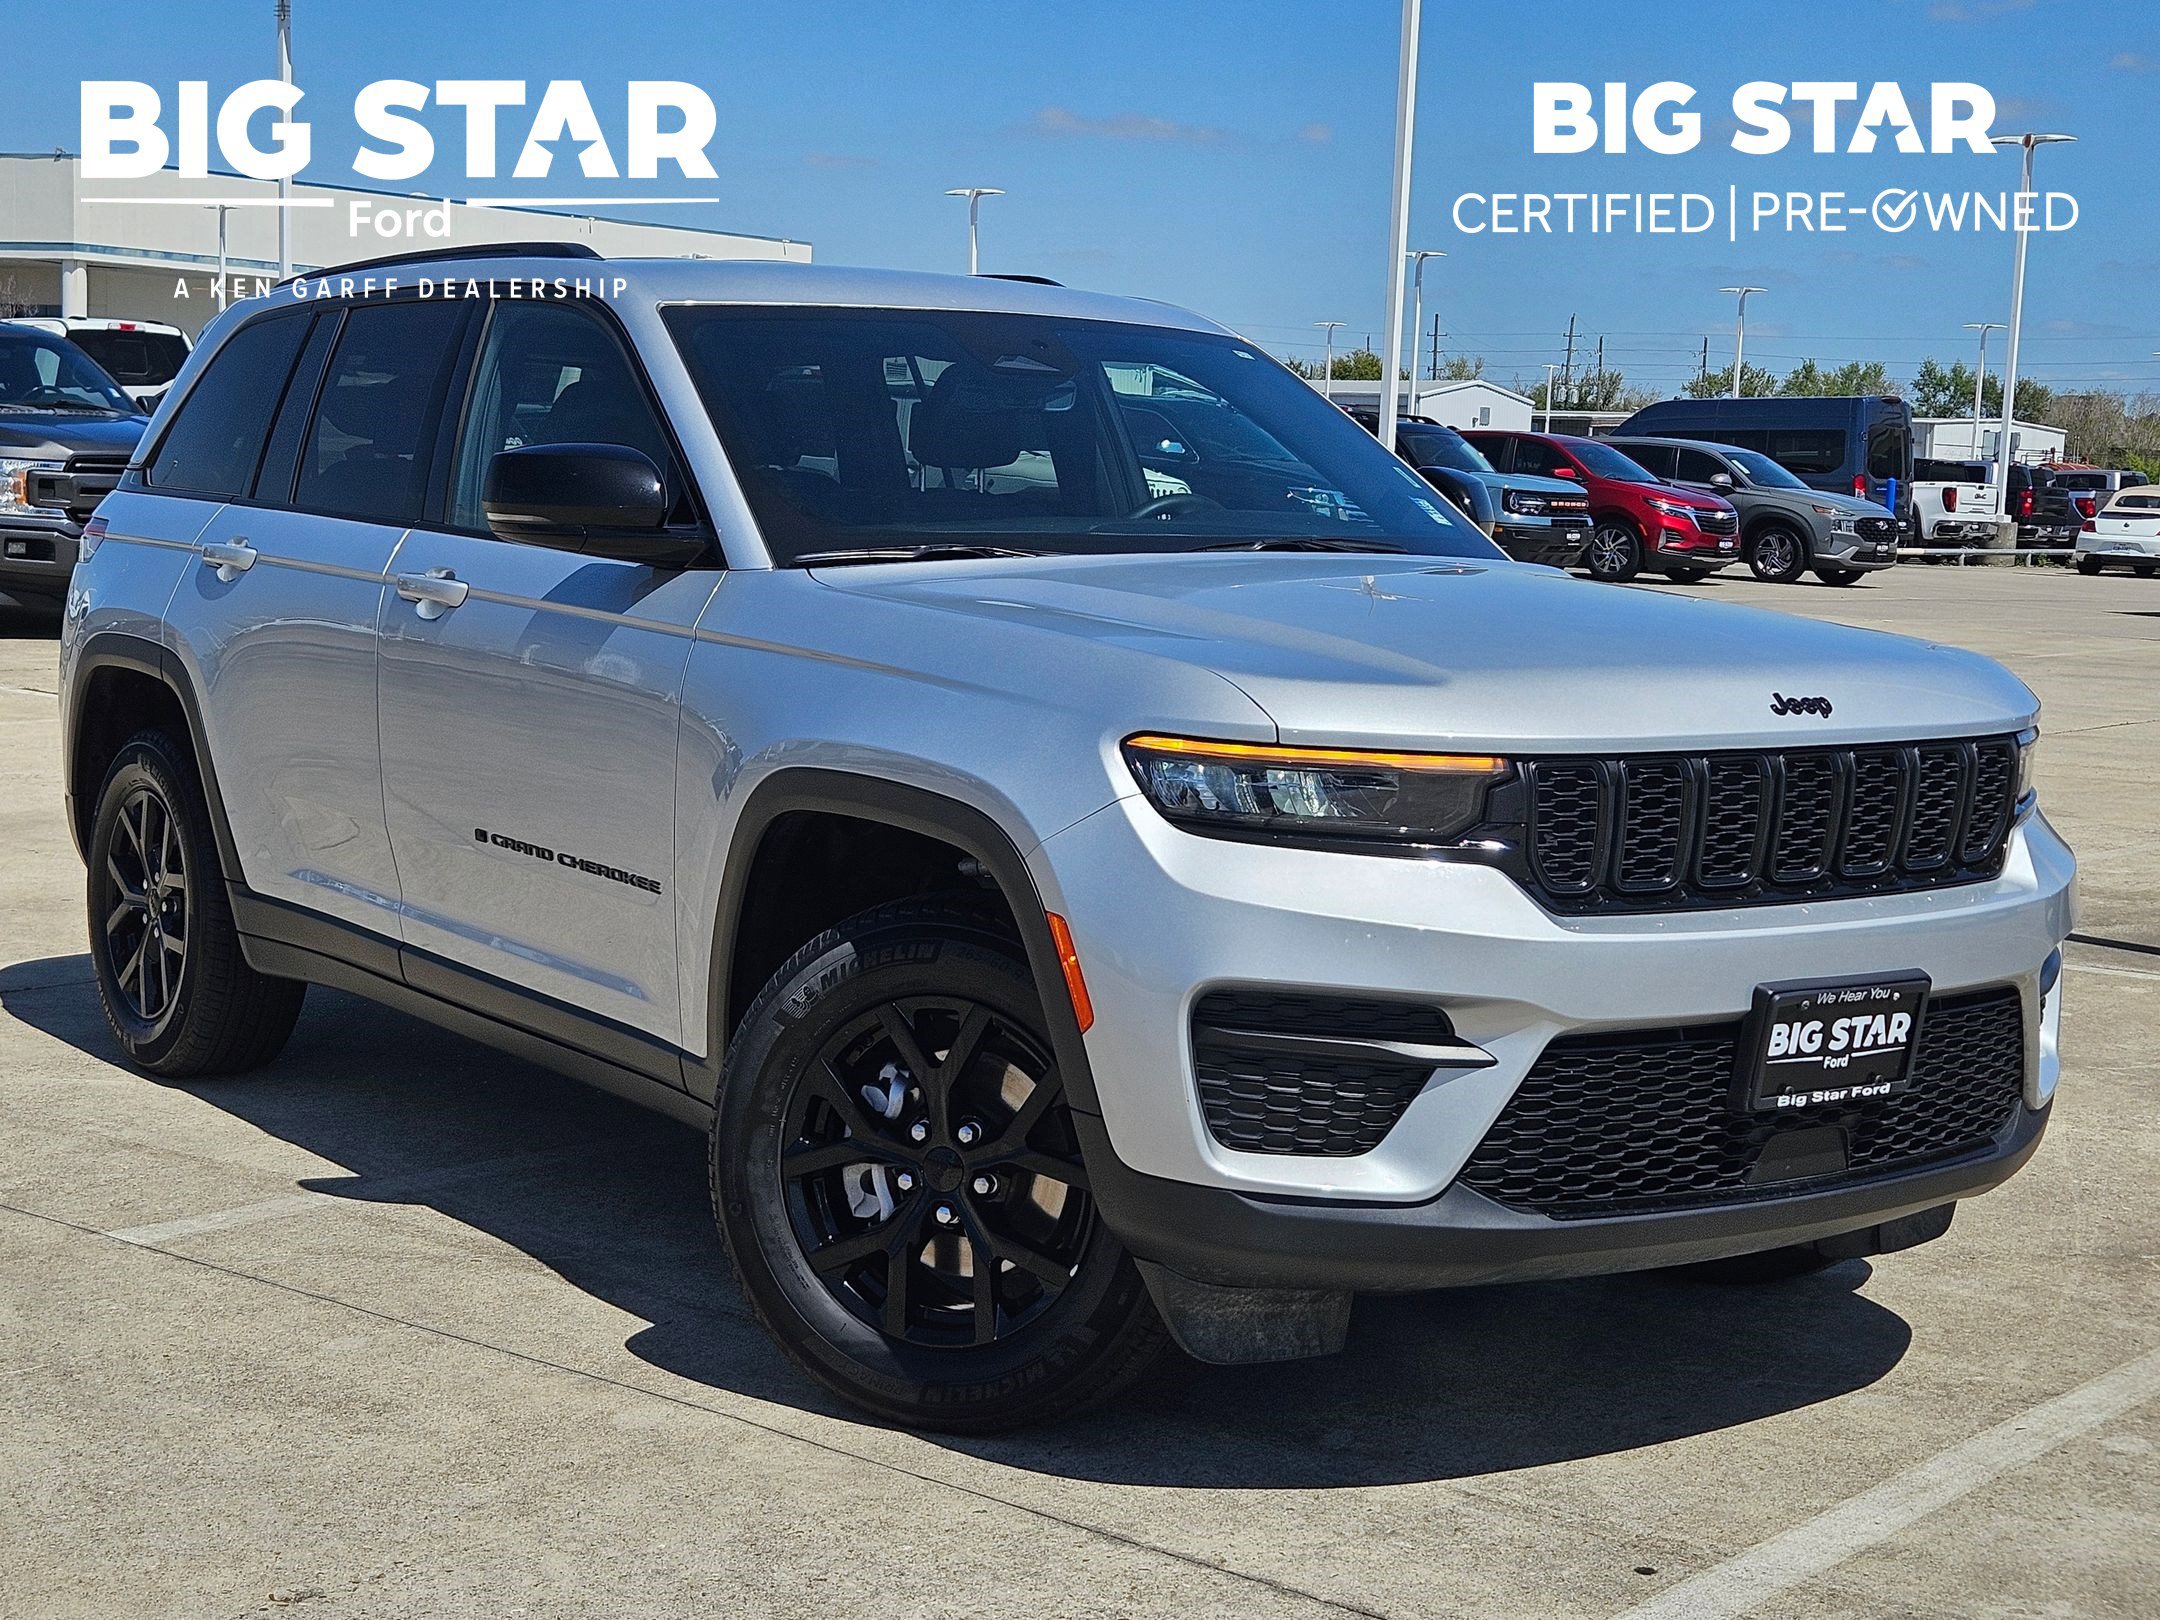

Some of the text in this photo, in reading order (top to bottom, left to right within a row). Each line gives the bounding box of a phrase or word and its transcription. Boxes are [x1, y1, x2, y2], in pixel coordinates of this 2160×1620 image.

[1770, 692, 1833, 719] Jeep
[490, 833, 662, 895] GRAND CHEROKEE
[818, 943, 938, 992] MICHELIN
[1816, 987, 1891, 1004] We Hear You
[1767, 1012, 1912, 1057] BIG STAR
[1823, 1054, 1850, 1070] Ford
[1776, 1083, 1891, 1108] Big Star Ford
